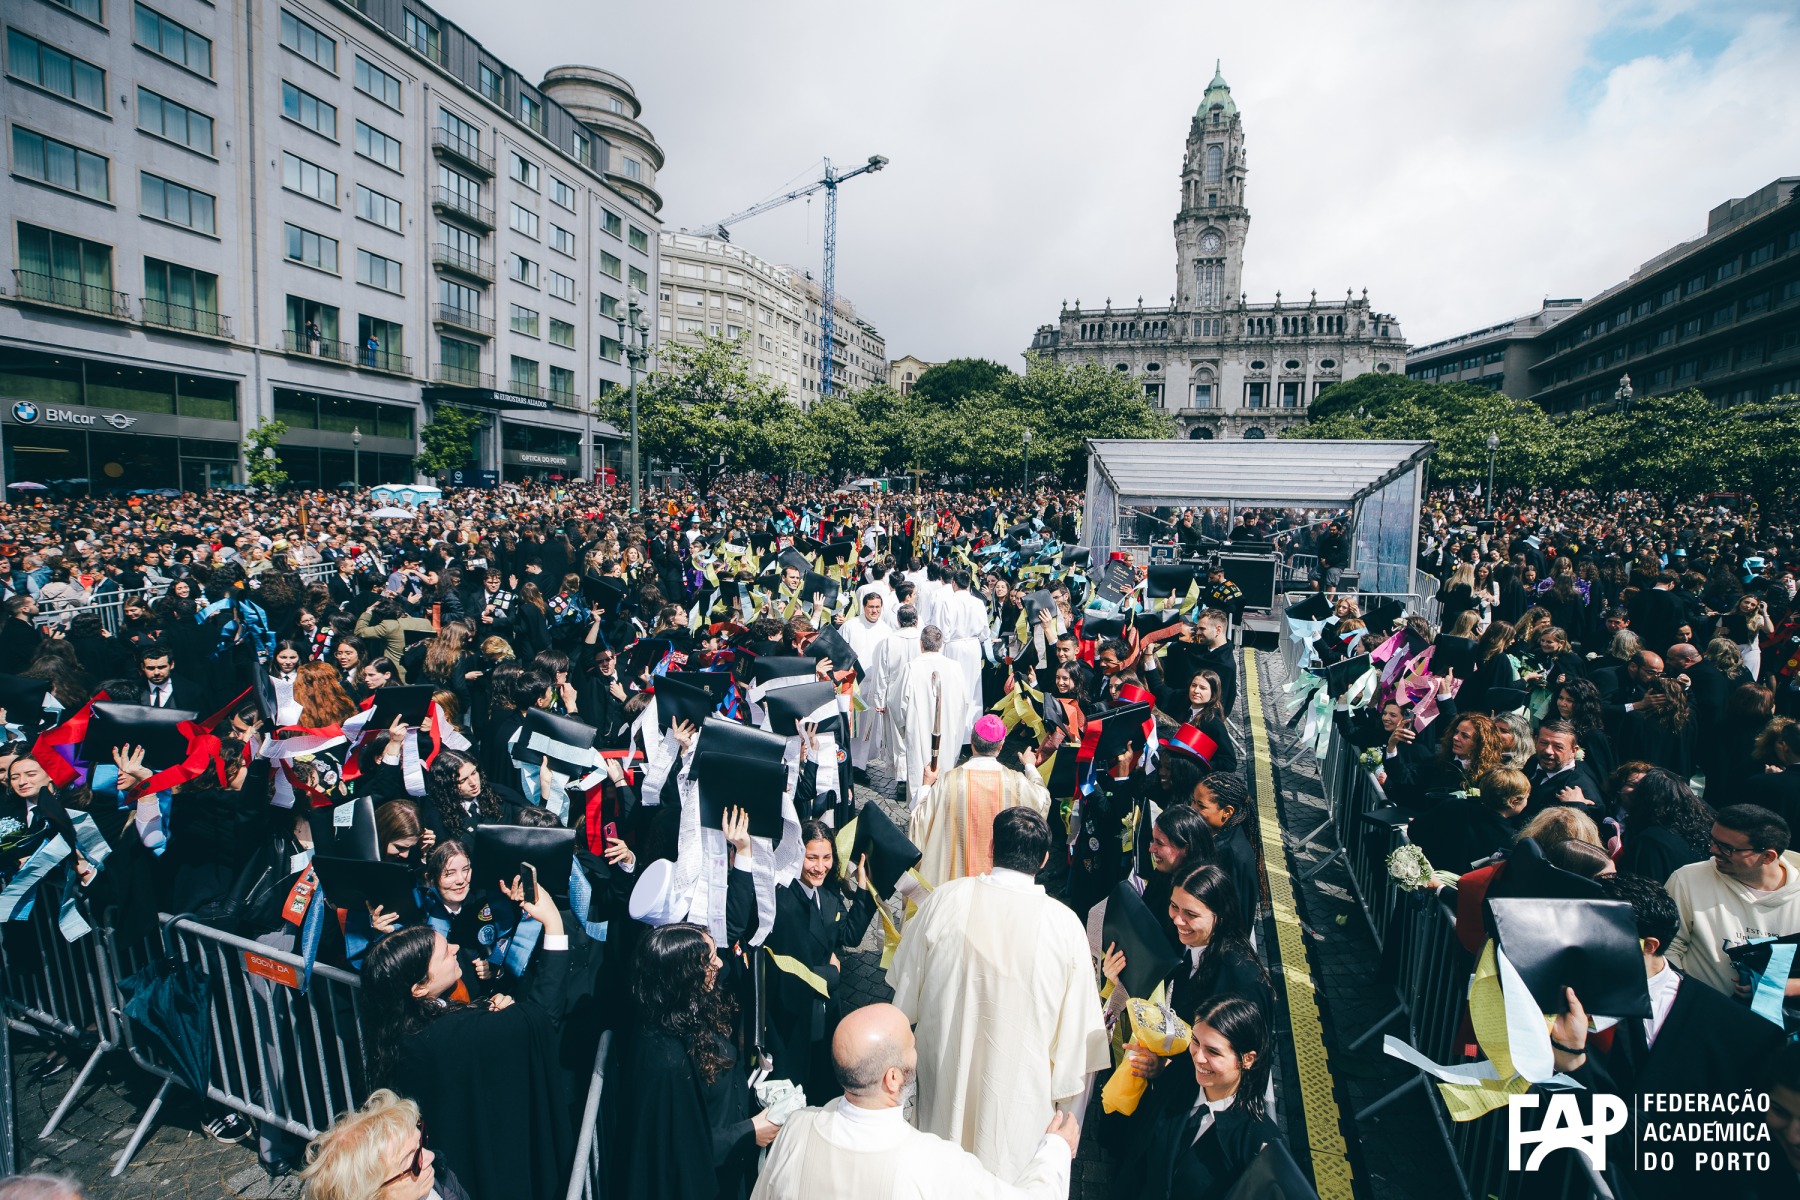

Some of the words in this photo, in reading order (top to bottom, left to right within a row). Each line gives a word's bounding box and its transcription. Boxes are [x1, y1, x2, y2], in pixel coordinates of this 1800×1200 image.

[500, 394, 527, 405] EUROSTARS
[527, 398, 548, 408] ALIADOS
[46, 409, 96, 425] BMcar
[550, 457, 567, 465] PORTO
